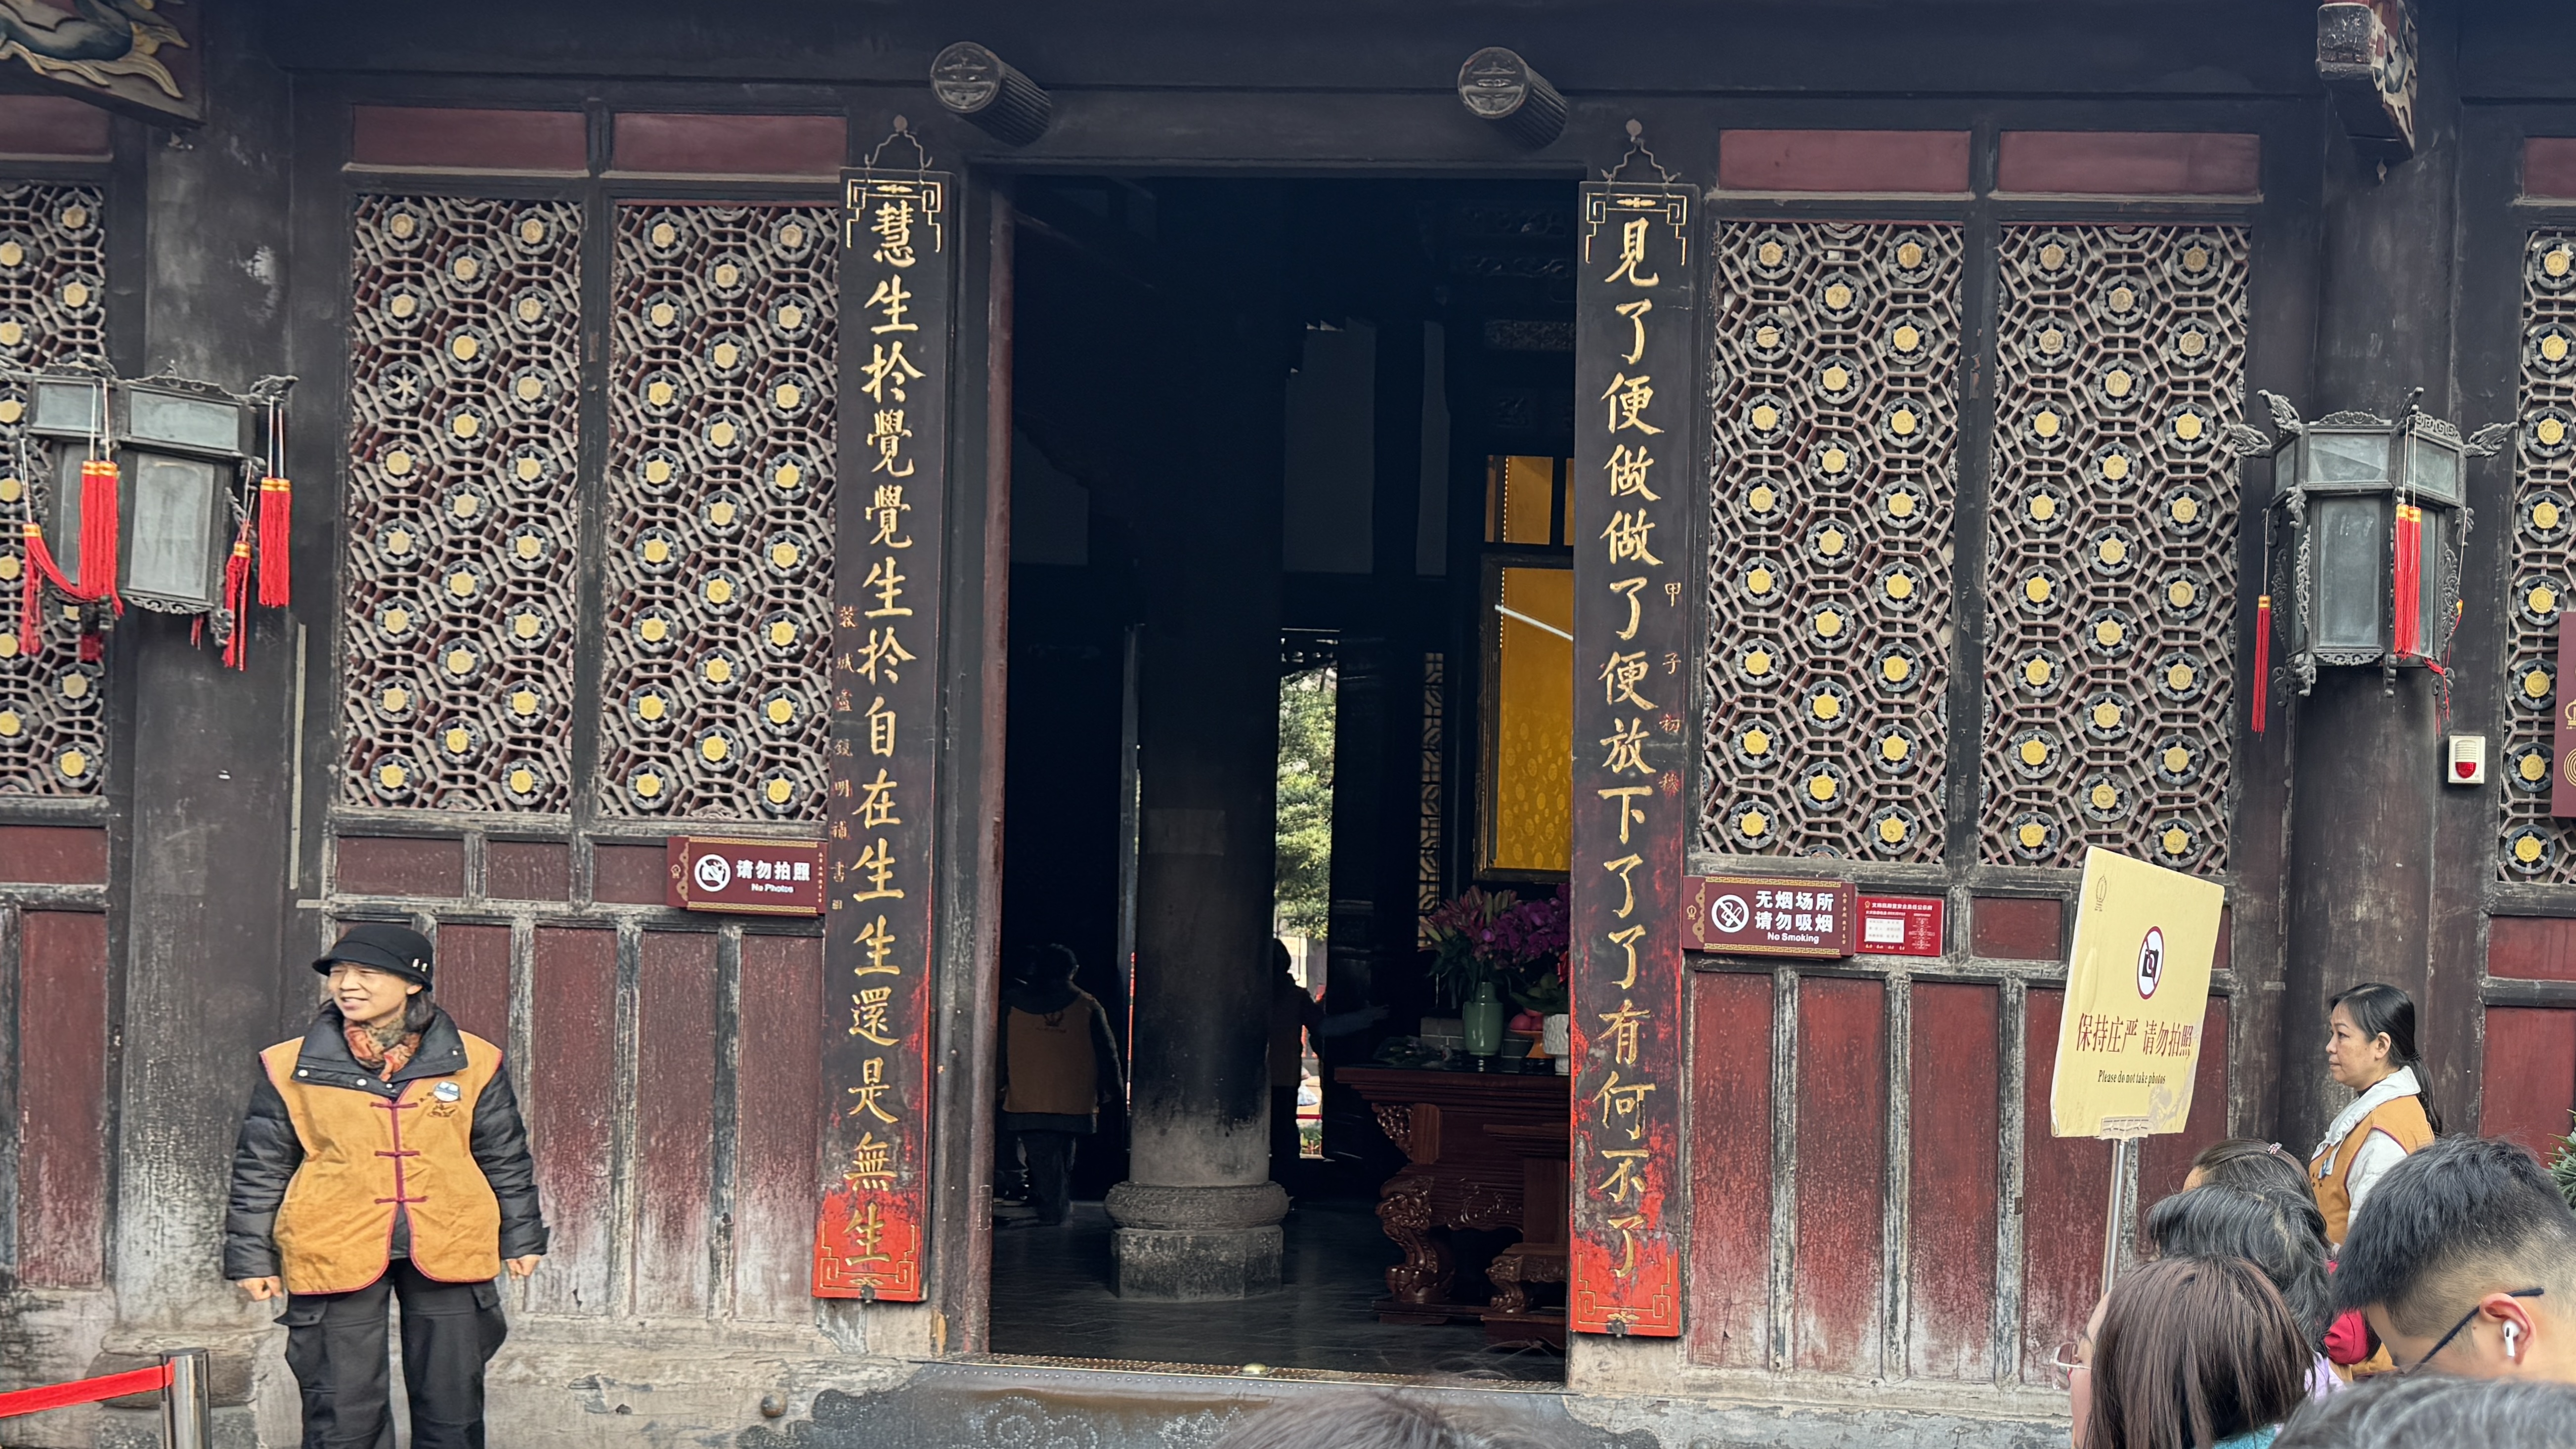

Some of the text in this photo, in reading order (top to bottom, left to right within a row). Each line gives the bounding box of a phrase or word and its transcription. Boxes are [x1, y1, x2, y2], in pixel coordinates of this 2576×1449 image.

[1592, 216, 1664, 1278] 見了便做做了便放下了了有何不了
[736, 859, 810, 881] 请勿拍照
[751, 883, 794, 893] No Photos
[1756, 891, 1834, 911] 无烟场所
[1755, 911, 1833, 933] 请勿吸烟
[1767, 932, 1819, 944] No Smoking
[2076, 1012, 2193, 1057] 保持庄严 请勿拍照
[2098, 1069, 2166, 1087] Please do not take photos
